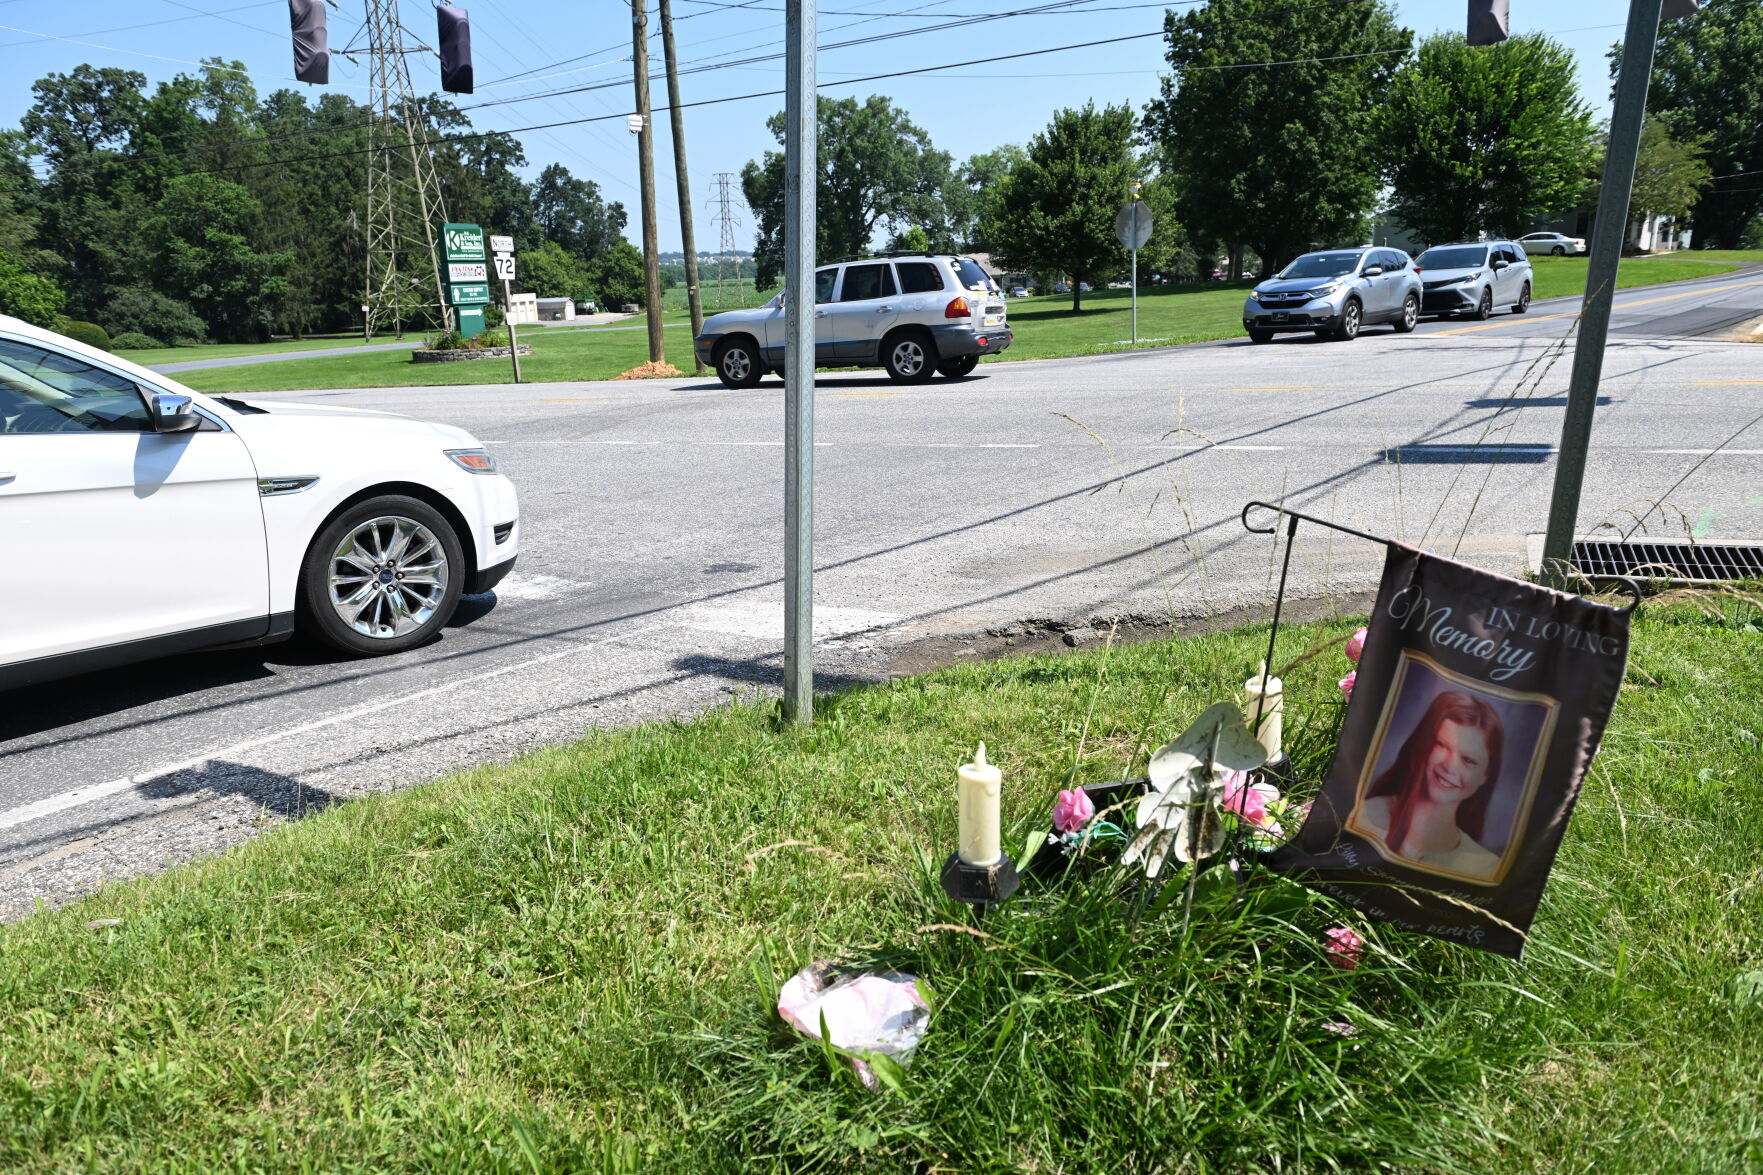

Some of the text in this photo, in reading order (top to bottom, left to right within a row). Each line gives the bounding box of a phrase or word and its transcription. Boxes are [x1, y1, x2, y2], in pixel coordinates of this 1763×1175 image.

[492, 238, 512, 248] NORTH
[496, 259, 514, 274] 72
[1388, 584, 1537, 681] Memory
[1487, 607, 1622, 656] IN LOVING
